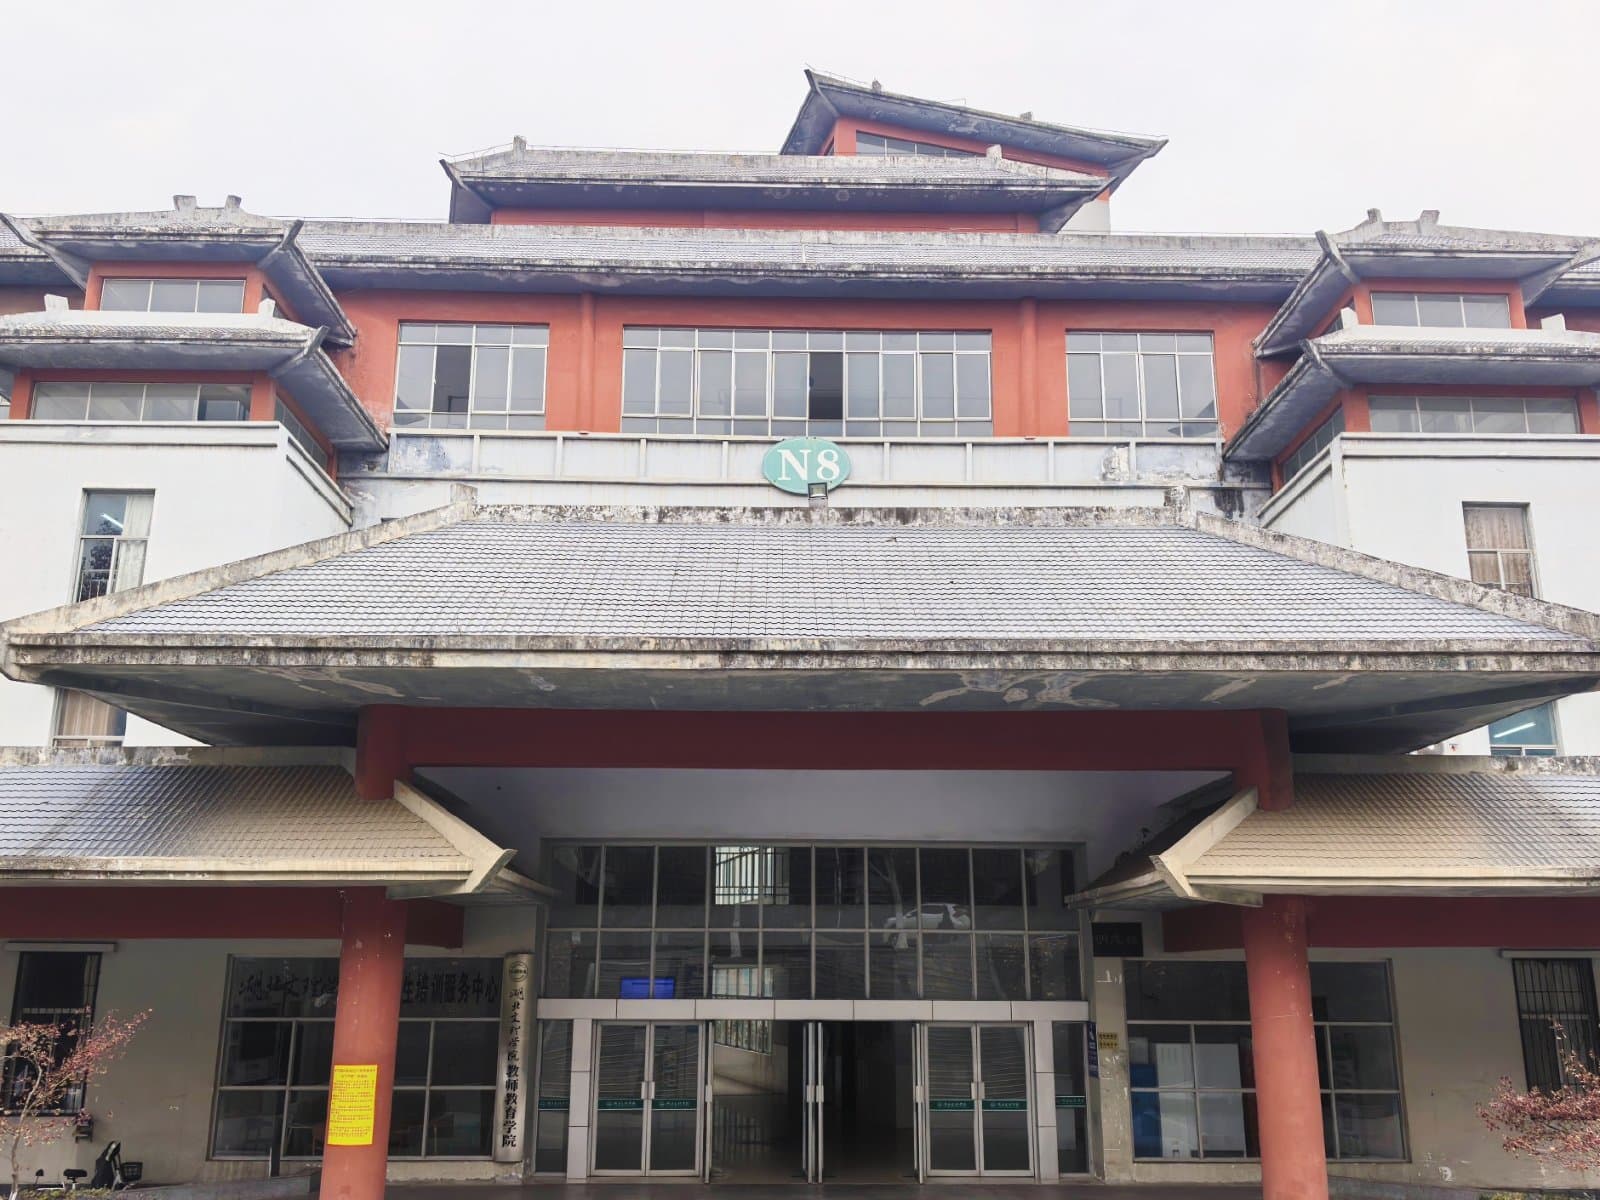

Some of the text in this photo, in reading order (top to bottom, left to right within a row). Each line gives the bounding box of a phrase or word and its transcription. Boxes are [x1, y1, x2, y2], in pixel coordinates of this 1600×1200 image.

[777, 449, 840, 480] N8
[502, 987, 524, 1148] 湖北文理学院教师教育学院
